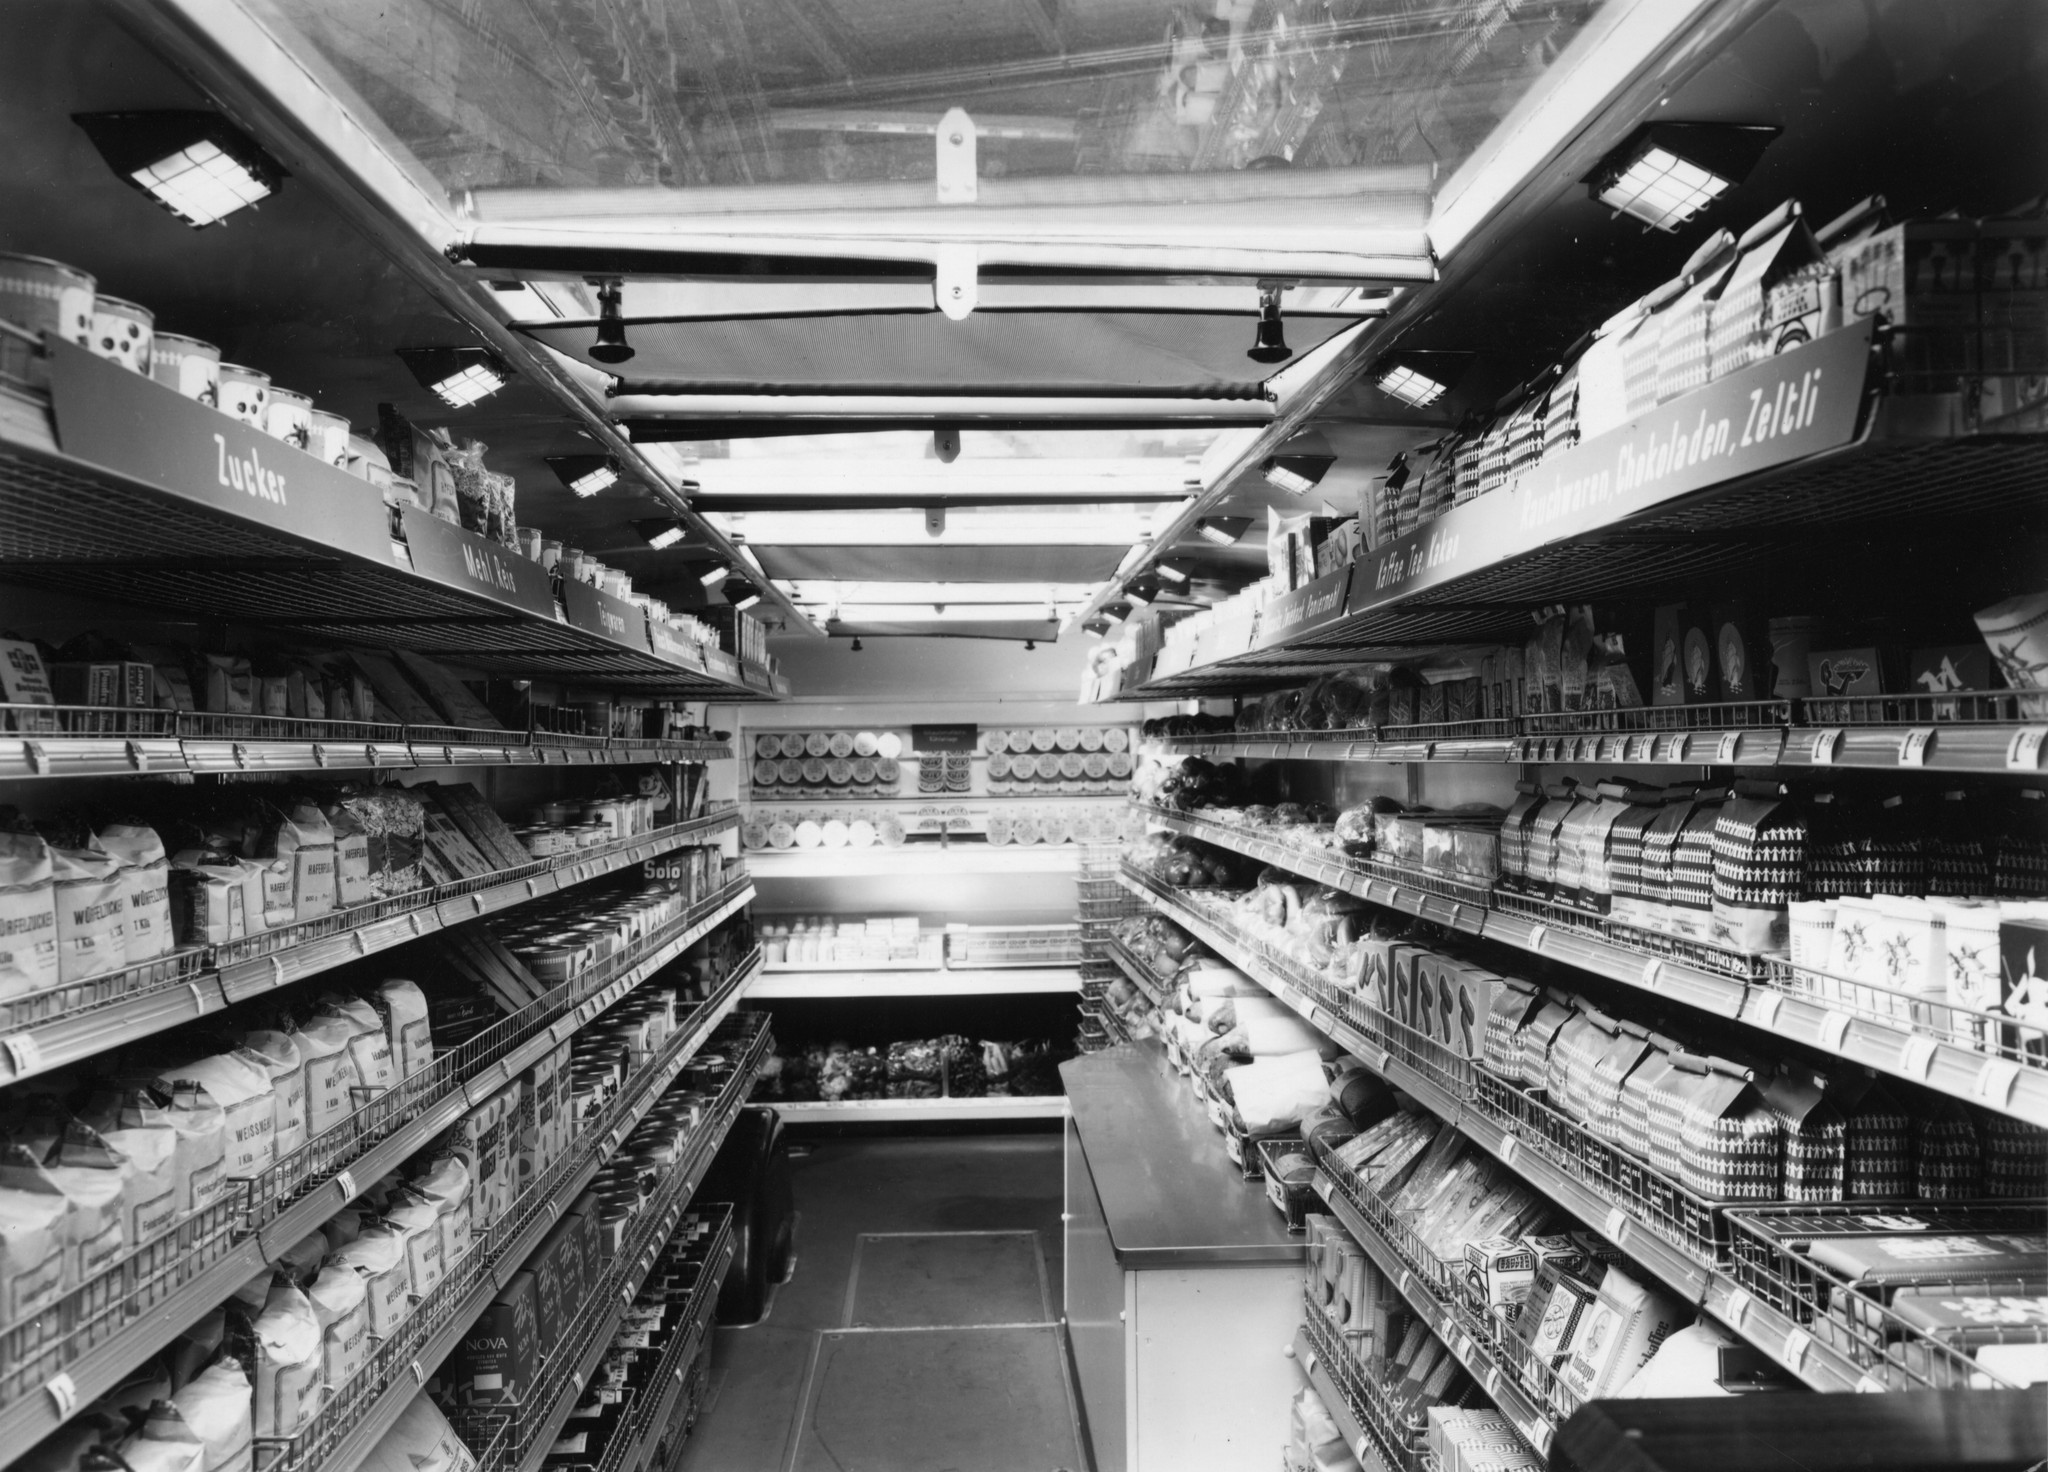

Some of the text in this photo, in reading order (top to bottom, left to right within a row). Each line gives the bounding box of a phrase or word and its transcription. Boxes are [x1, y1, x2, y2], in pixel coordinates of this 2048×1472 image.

[1616, 409, 1737, 495] Chokoladen,
[1740, 368, 1822, 448] Zeltli
[213, 433, 287, 506] Zucker
[1426, 528, 1460, 569] Kakao
[644, 860, 682, 881] Solo
[73, 899, 123, 926] WÜRFELZUCKE
[465, 1336, 509, 1351] NOVA
